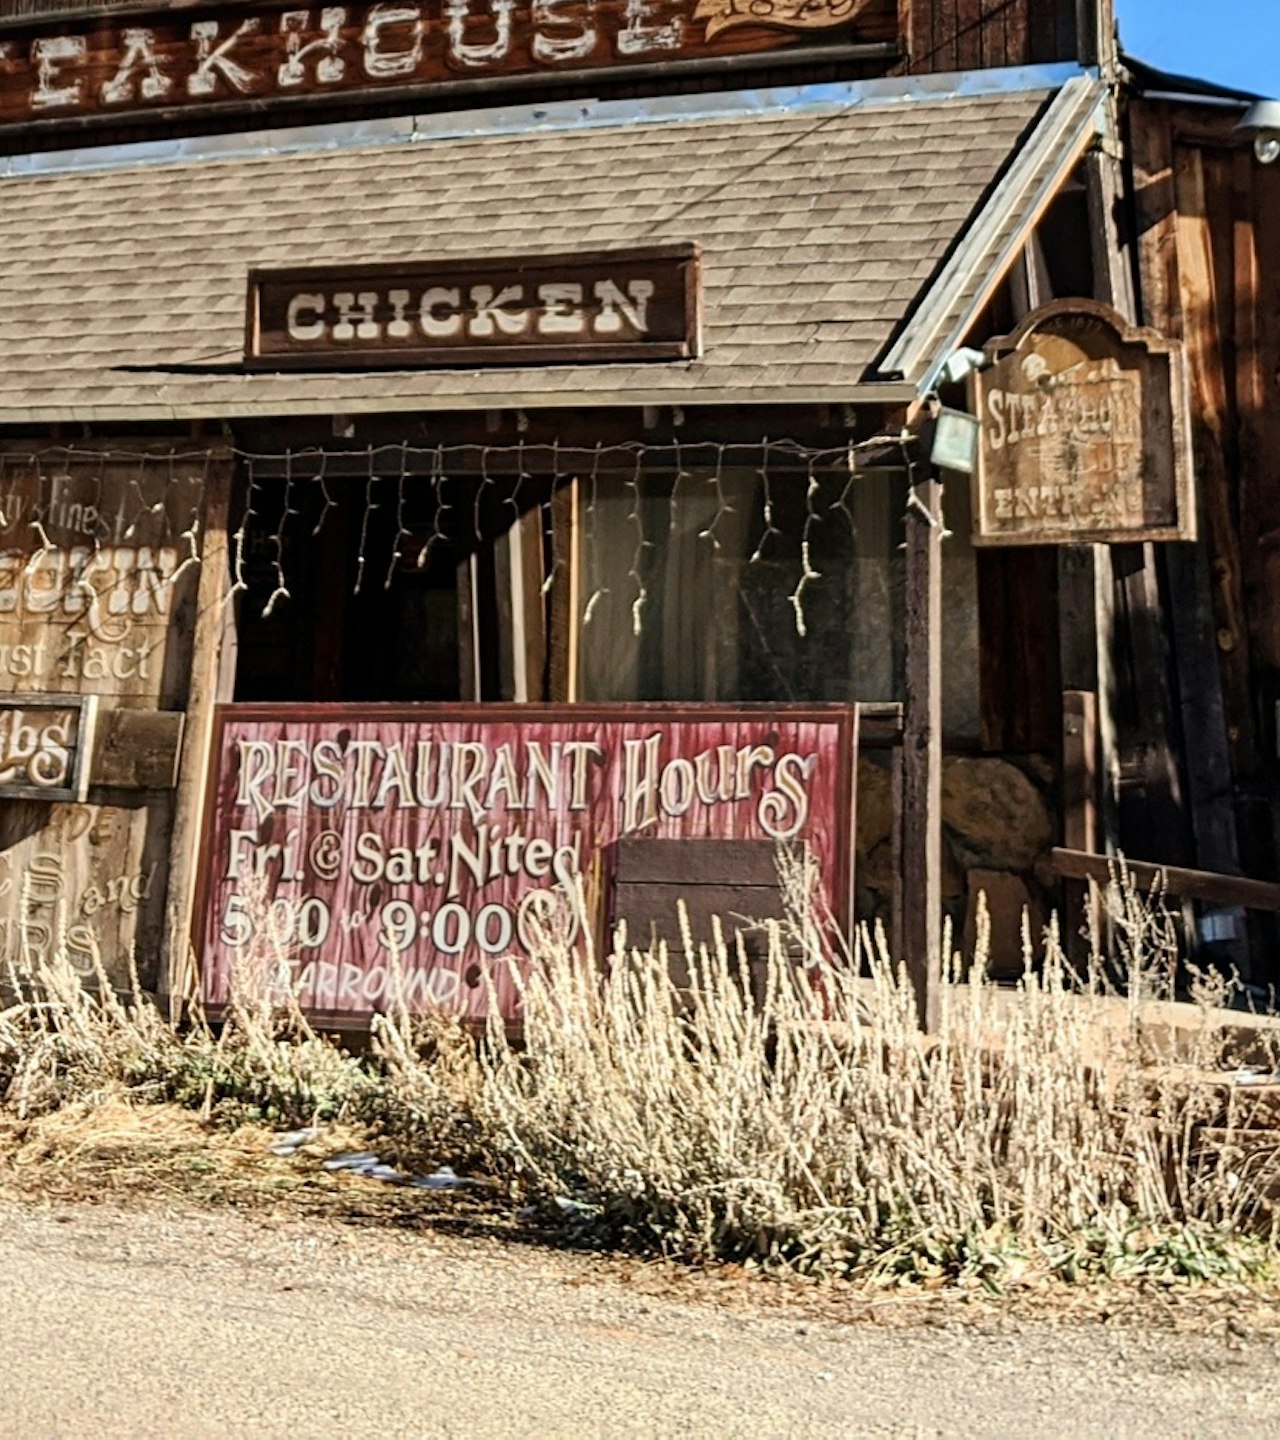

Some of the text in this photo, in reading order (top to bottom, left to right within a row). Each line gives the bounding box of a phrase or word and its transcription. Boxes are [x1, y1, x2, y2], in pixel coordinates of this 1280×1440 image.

[287, 279, 655, 340] CHICKEN
[62, 630, 151, 678] Fact
[236, 733, 817, 838] RESTAURANT Hours
[225, 828, 305, 881] Fri.
[220, 894, 331, 948] 500
[379, 898, 513, 954] 9:00
